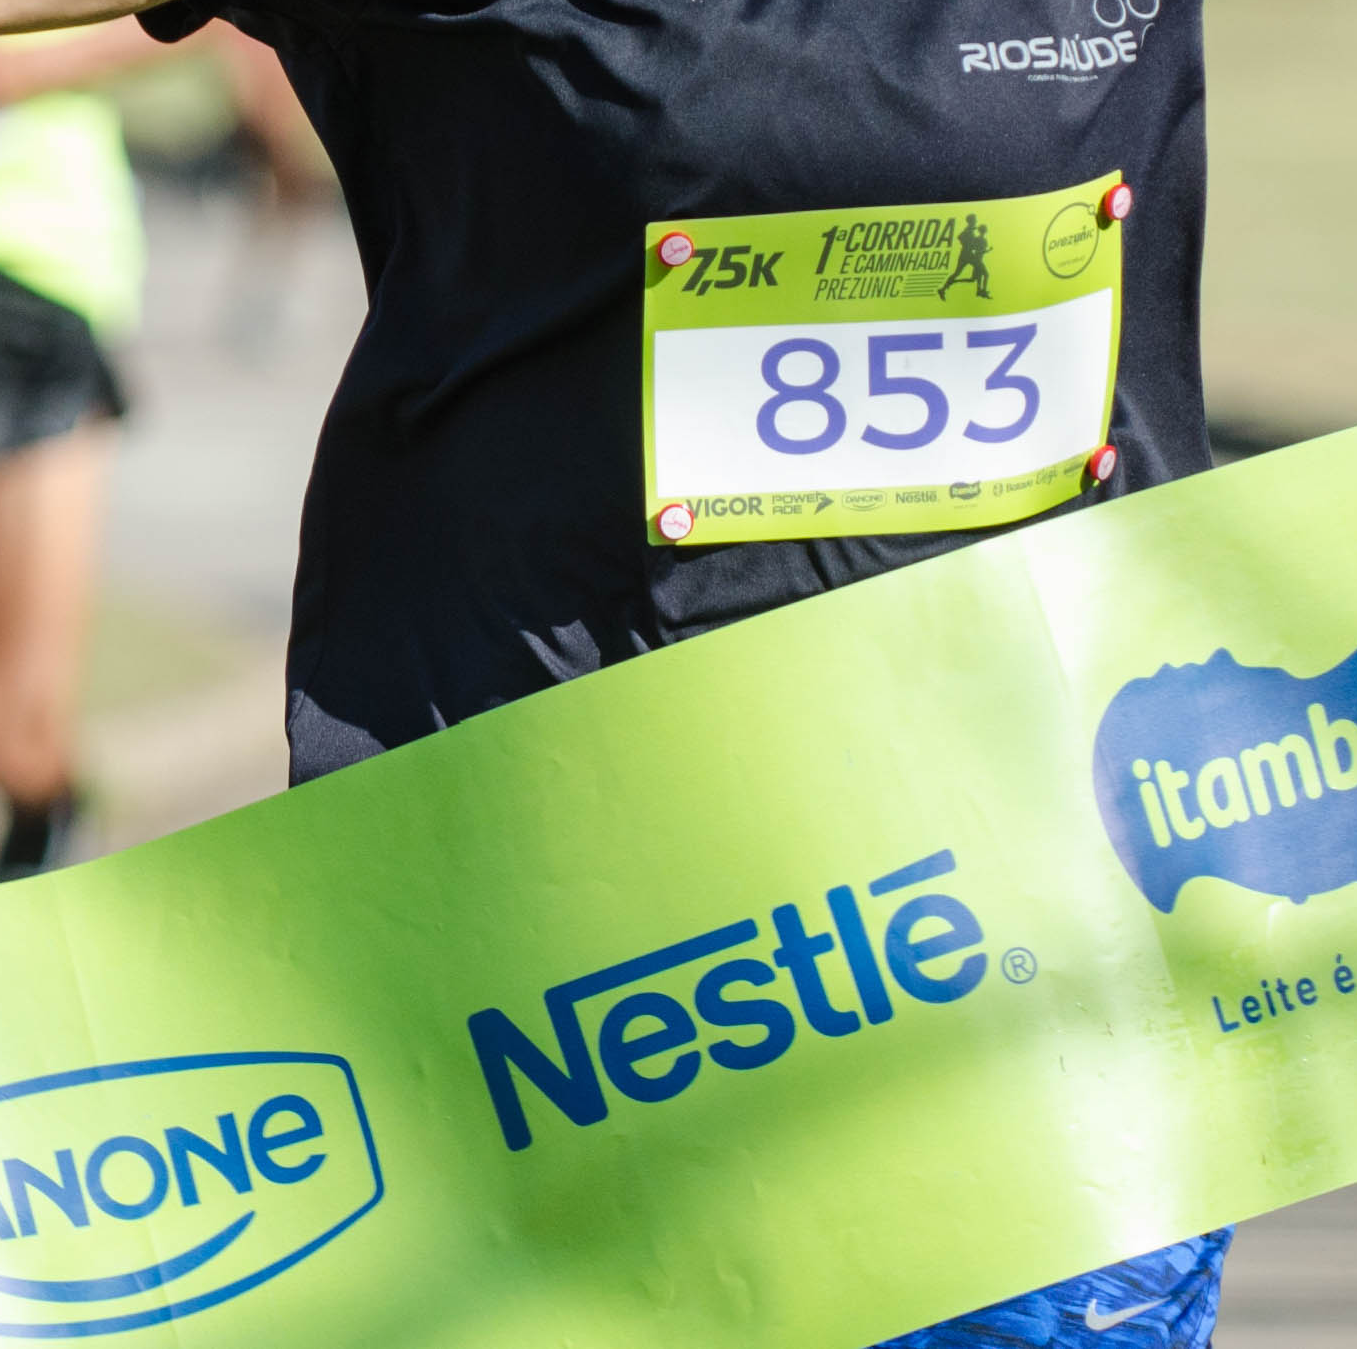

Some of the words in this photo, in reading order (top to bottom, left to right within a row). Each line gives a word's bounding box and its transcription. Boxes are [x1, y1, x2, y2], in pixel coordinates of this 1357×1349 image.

[959, 29, 1137, 72] RIOSAÚDE
[845, 217, 956, 251] CORRIDA
[840, 254, 854, 275] E
[853, 251, 950, 274] CAMINHADA
[815, 275, 903, 300] PREZUNIC
[756, 323, 1041, 455] 853
[686, 497, 764, 519] VIGOR
[467, 848, 988, 1151] Nestlé
[1211, 978, 1318, 1032] Leite
[1332, 952, 1357, 994] é
